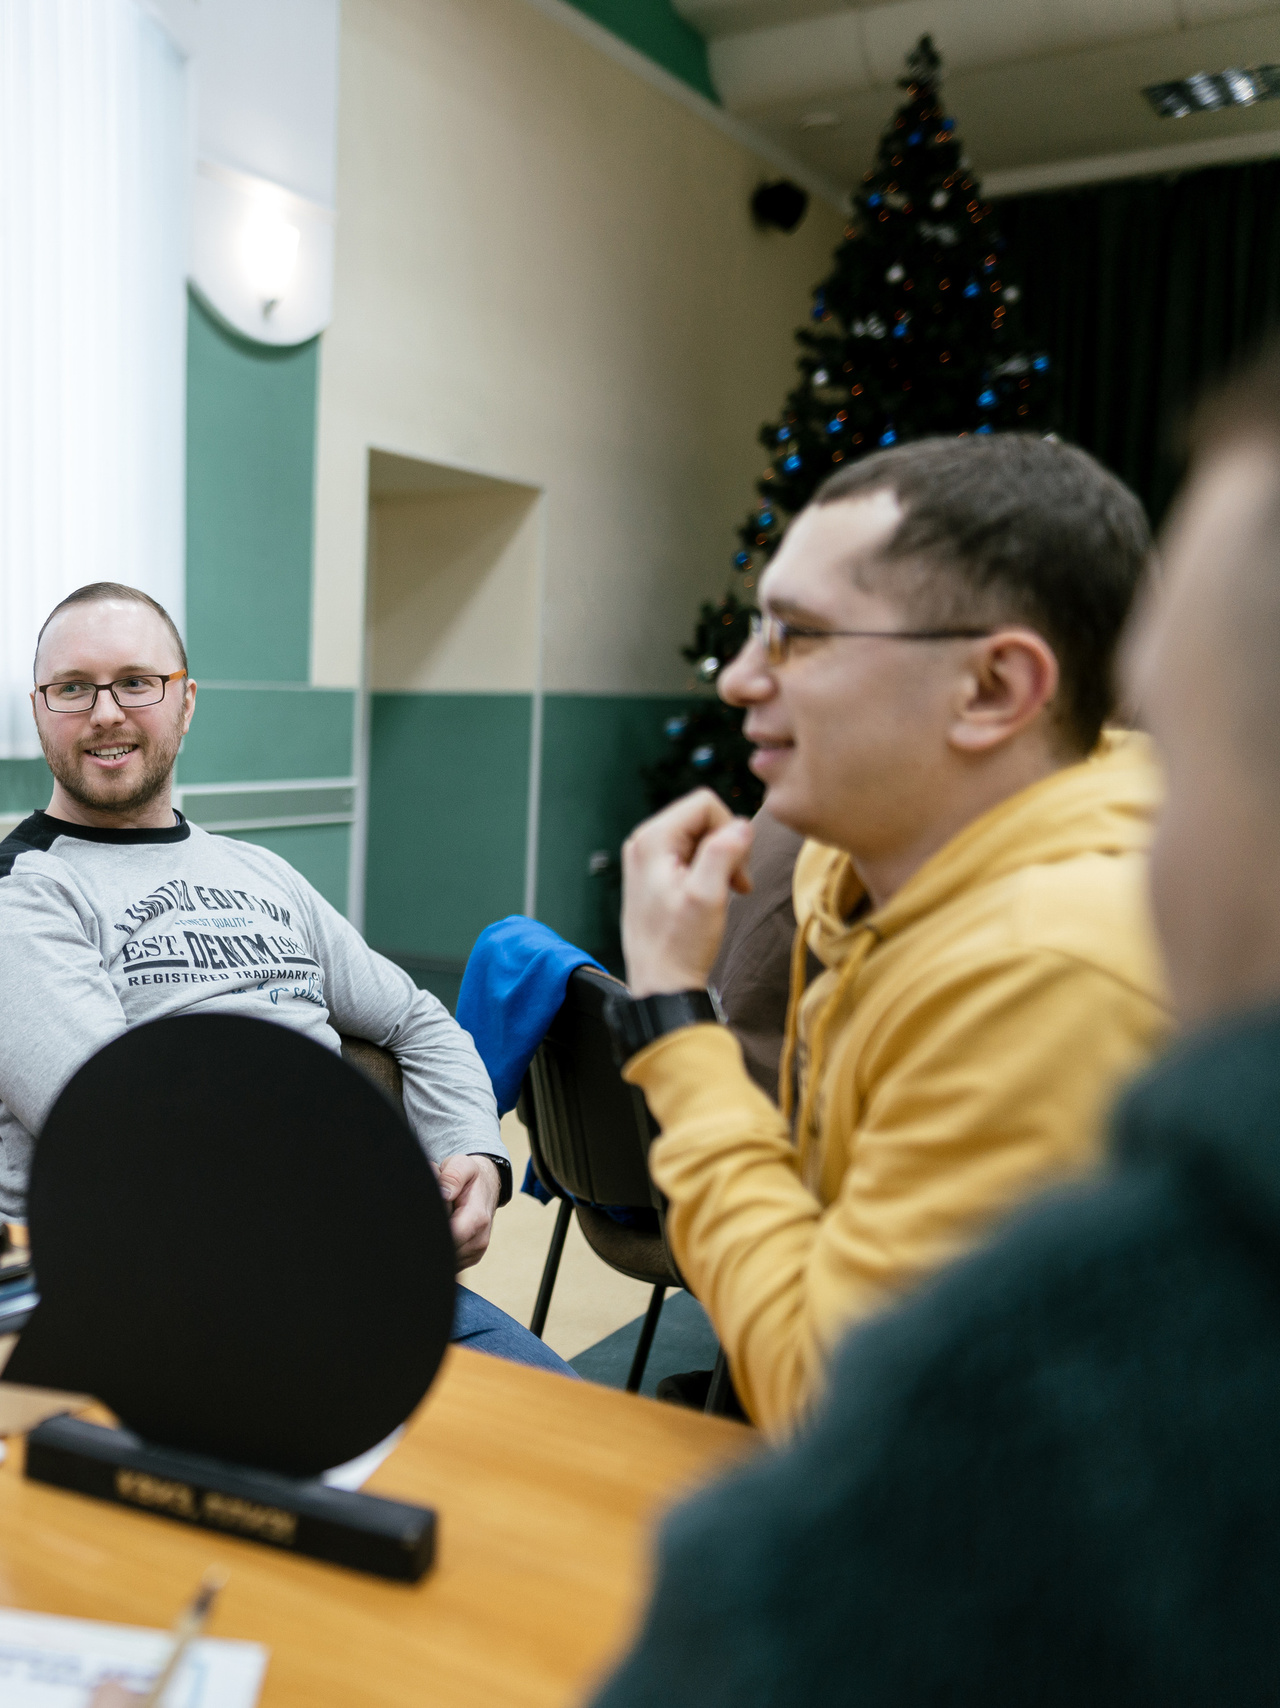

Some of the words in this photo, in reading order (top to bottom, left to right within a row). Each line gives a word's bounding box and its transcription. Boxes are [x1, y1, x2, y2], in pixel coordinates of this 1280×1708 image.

[193, 885, 293, 931] EDITION
[211, 917, 247, 929] QUALITY
[122, 935, 184, 964] EST.
[183, 930, 280, 970] DENIM
[128, 972, 229, 987] REGISTERED
[236, 969, 308, 982] TRADEMARK
